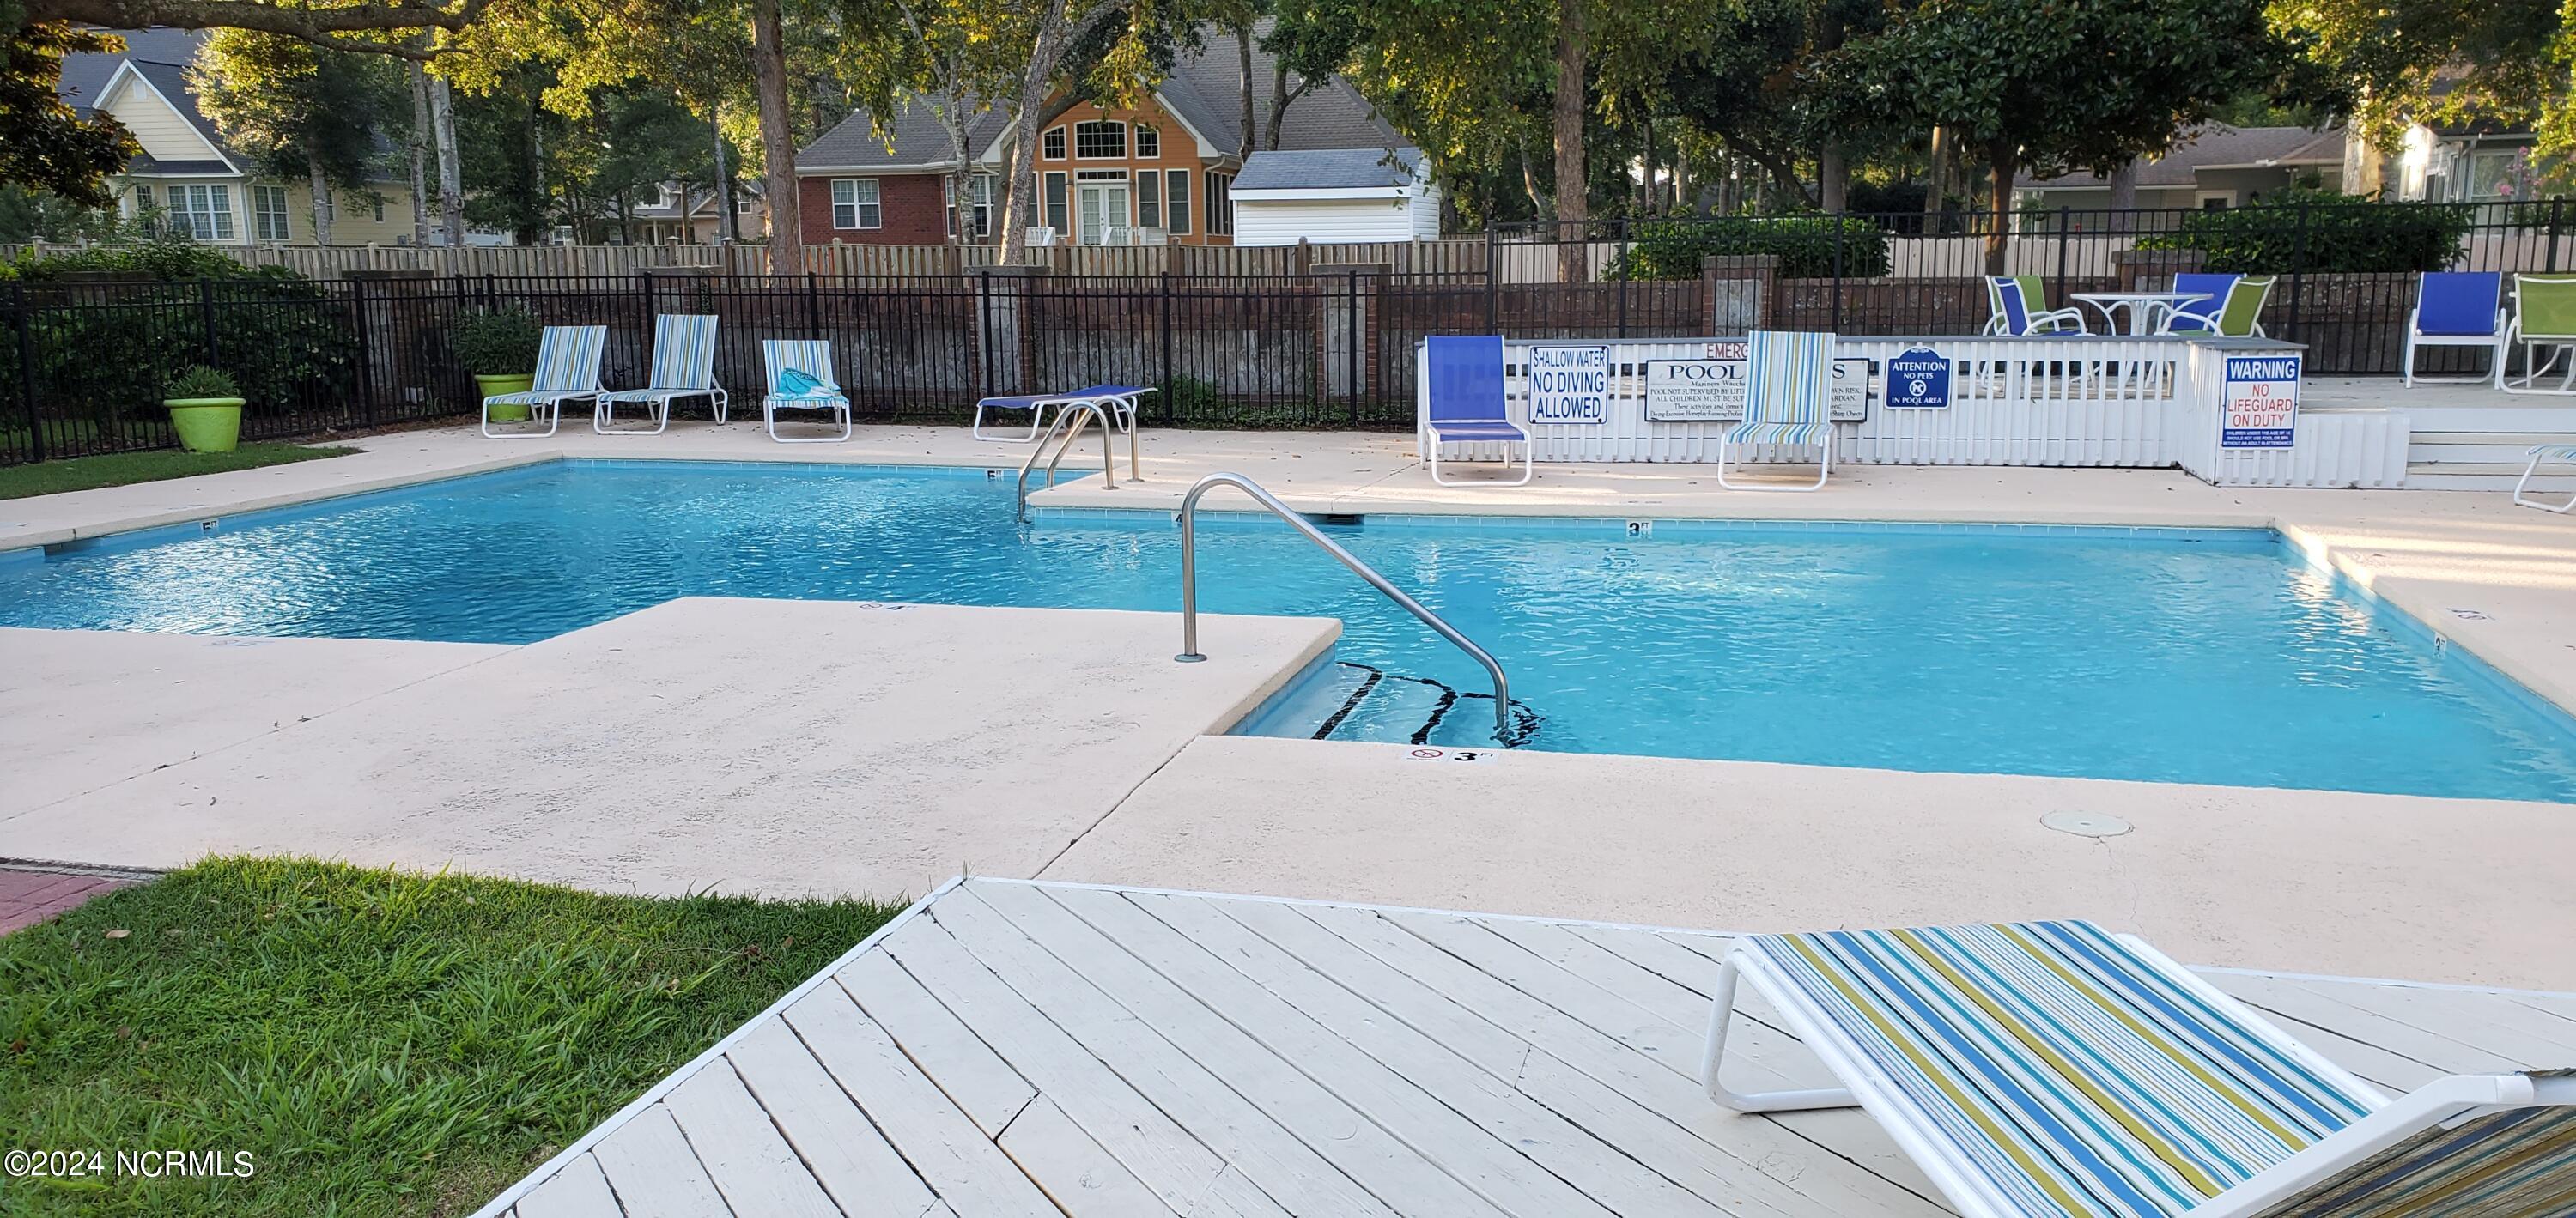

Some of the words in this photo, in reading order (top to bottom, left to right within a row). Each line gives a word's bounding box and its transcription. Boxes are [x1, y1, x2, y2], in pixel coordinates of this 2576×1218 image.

[1534, 350, 1574, 367] SHALLOW
[1577, 350, 1605, 367] WATER
[1706, 343, 1748, 359] EMERG
[1668, 364, 1745, 379] POOL
[1832, 363, 1845, 379] S
[1892, 361, 1947, 371] ATTENTION
[2230, 361, 2296, 379] WARNING
[1534, 371, 1552, 392] NO
[1558, 371, 1604, 392] DIVING
[2252, 384, 2269, 397] NO
[1535, 397, 1601, 418] ALLOWED
[2227, 399, 2293, 412] LIFEGUARD
[2233, 414, 2250, 427] ON
[2253, 414, 2285, 427] DUTY
[1629, 522, 1640, 537] 3
[1454, 752, 1478, 761] 3
